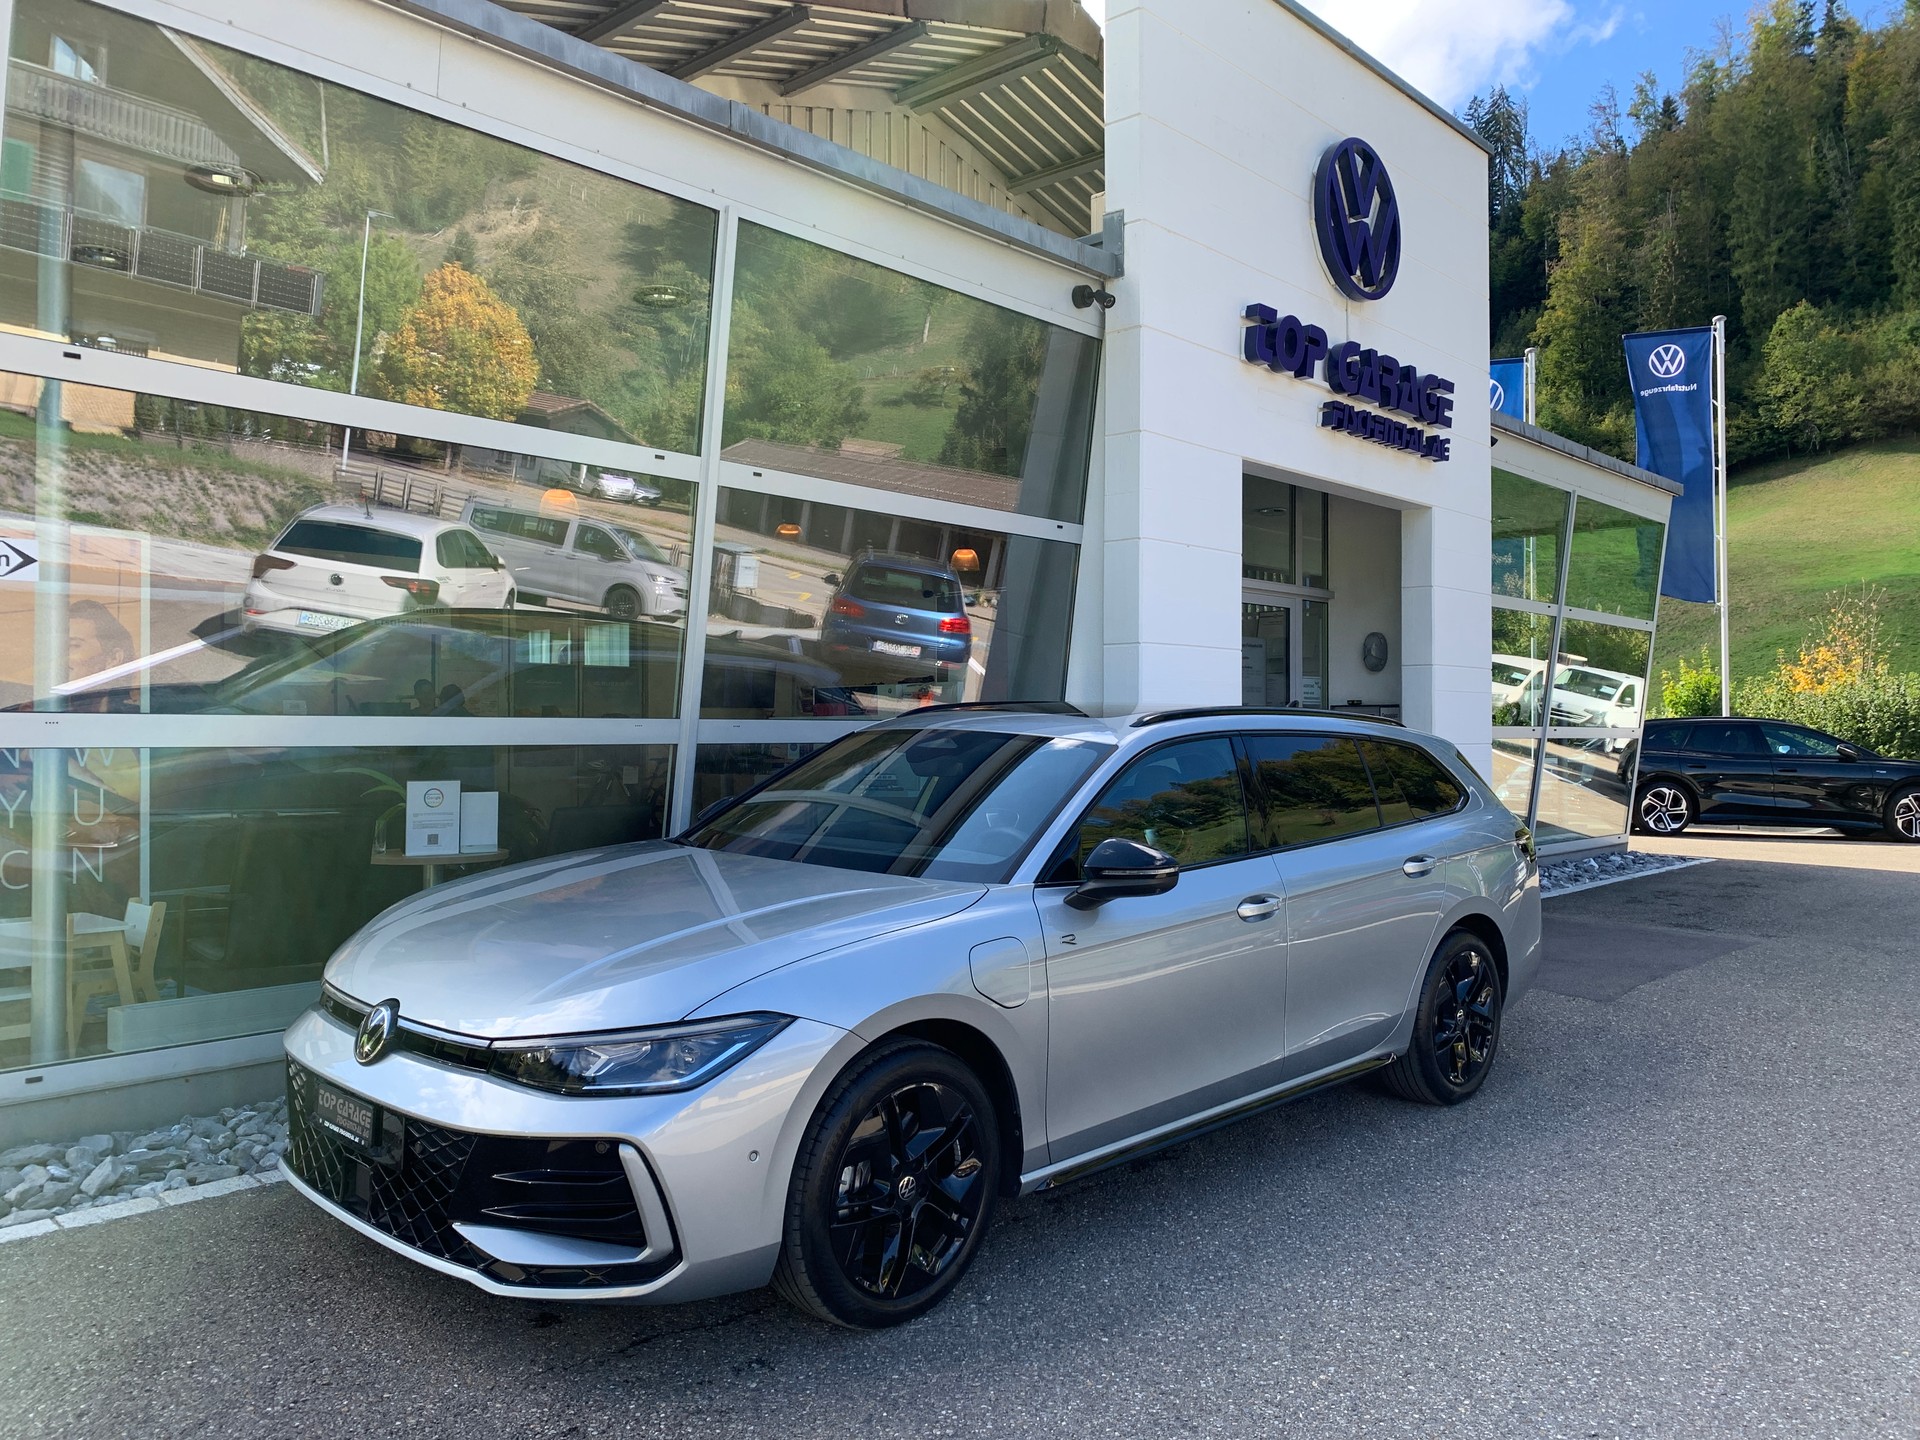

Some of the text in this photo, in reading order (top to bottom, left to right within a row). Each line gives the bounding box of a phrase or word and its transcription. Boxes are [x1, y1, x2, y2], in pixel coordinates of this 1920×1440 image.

[1243, 303, 1455, 429] TOP GARAGE
[319, 1088, 371, 1128] TOP GARAGE
